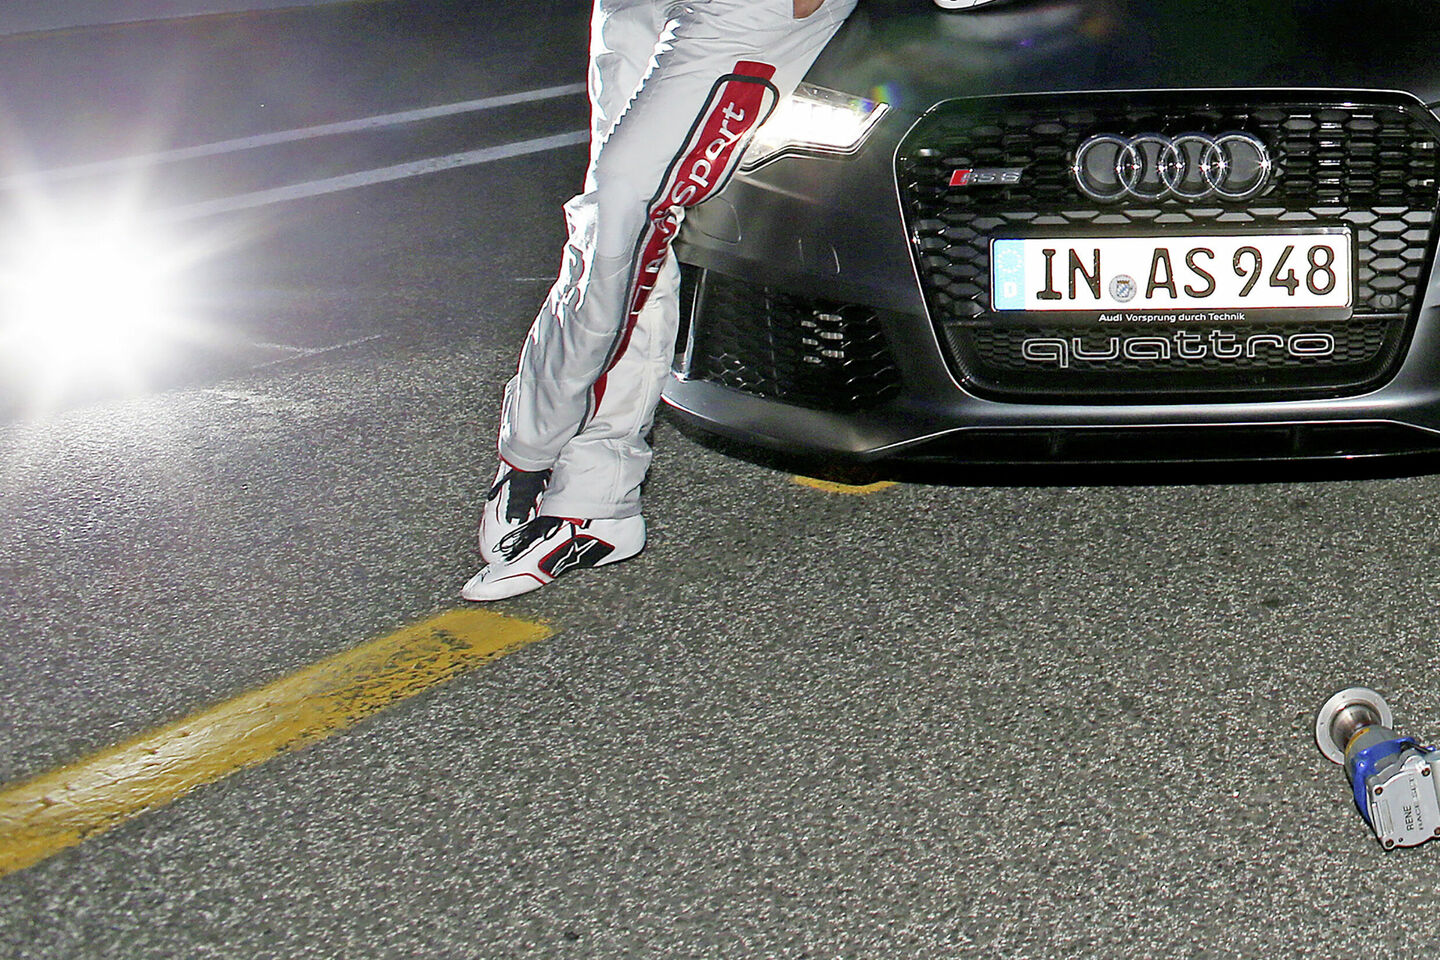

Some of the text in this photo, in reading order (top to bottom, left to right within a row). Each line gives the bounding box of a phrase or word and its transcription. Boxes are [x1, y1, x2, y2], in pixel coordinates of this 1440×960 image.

[670, 100, 746, 208] Sport
[1036, 244, 1337, 300] IN AS 948
[1099, 312, 1246, 323] Audi Vorsprung durch Technik
[1021, 329, 1335, 369] quattro
[1402, 805, 1414, 831] RENE
